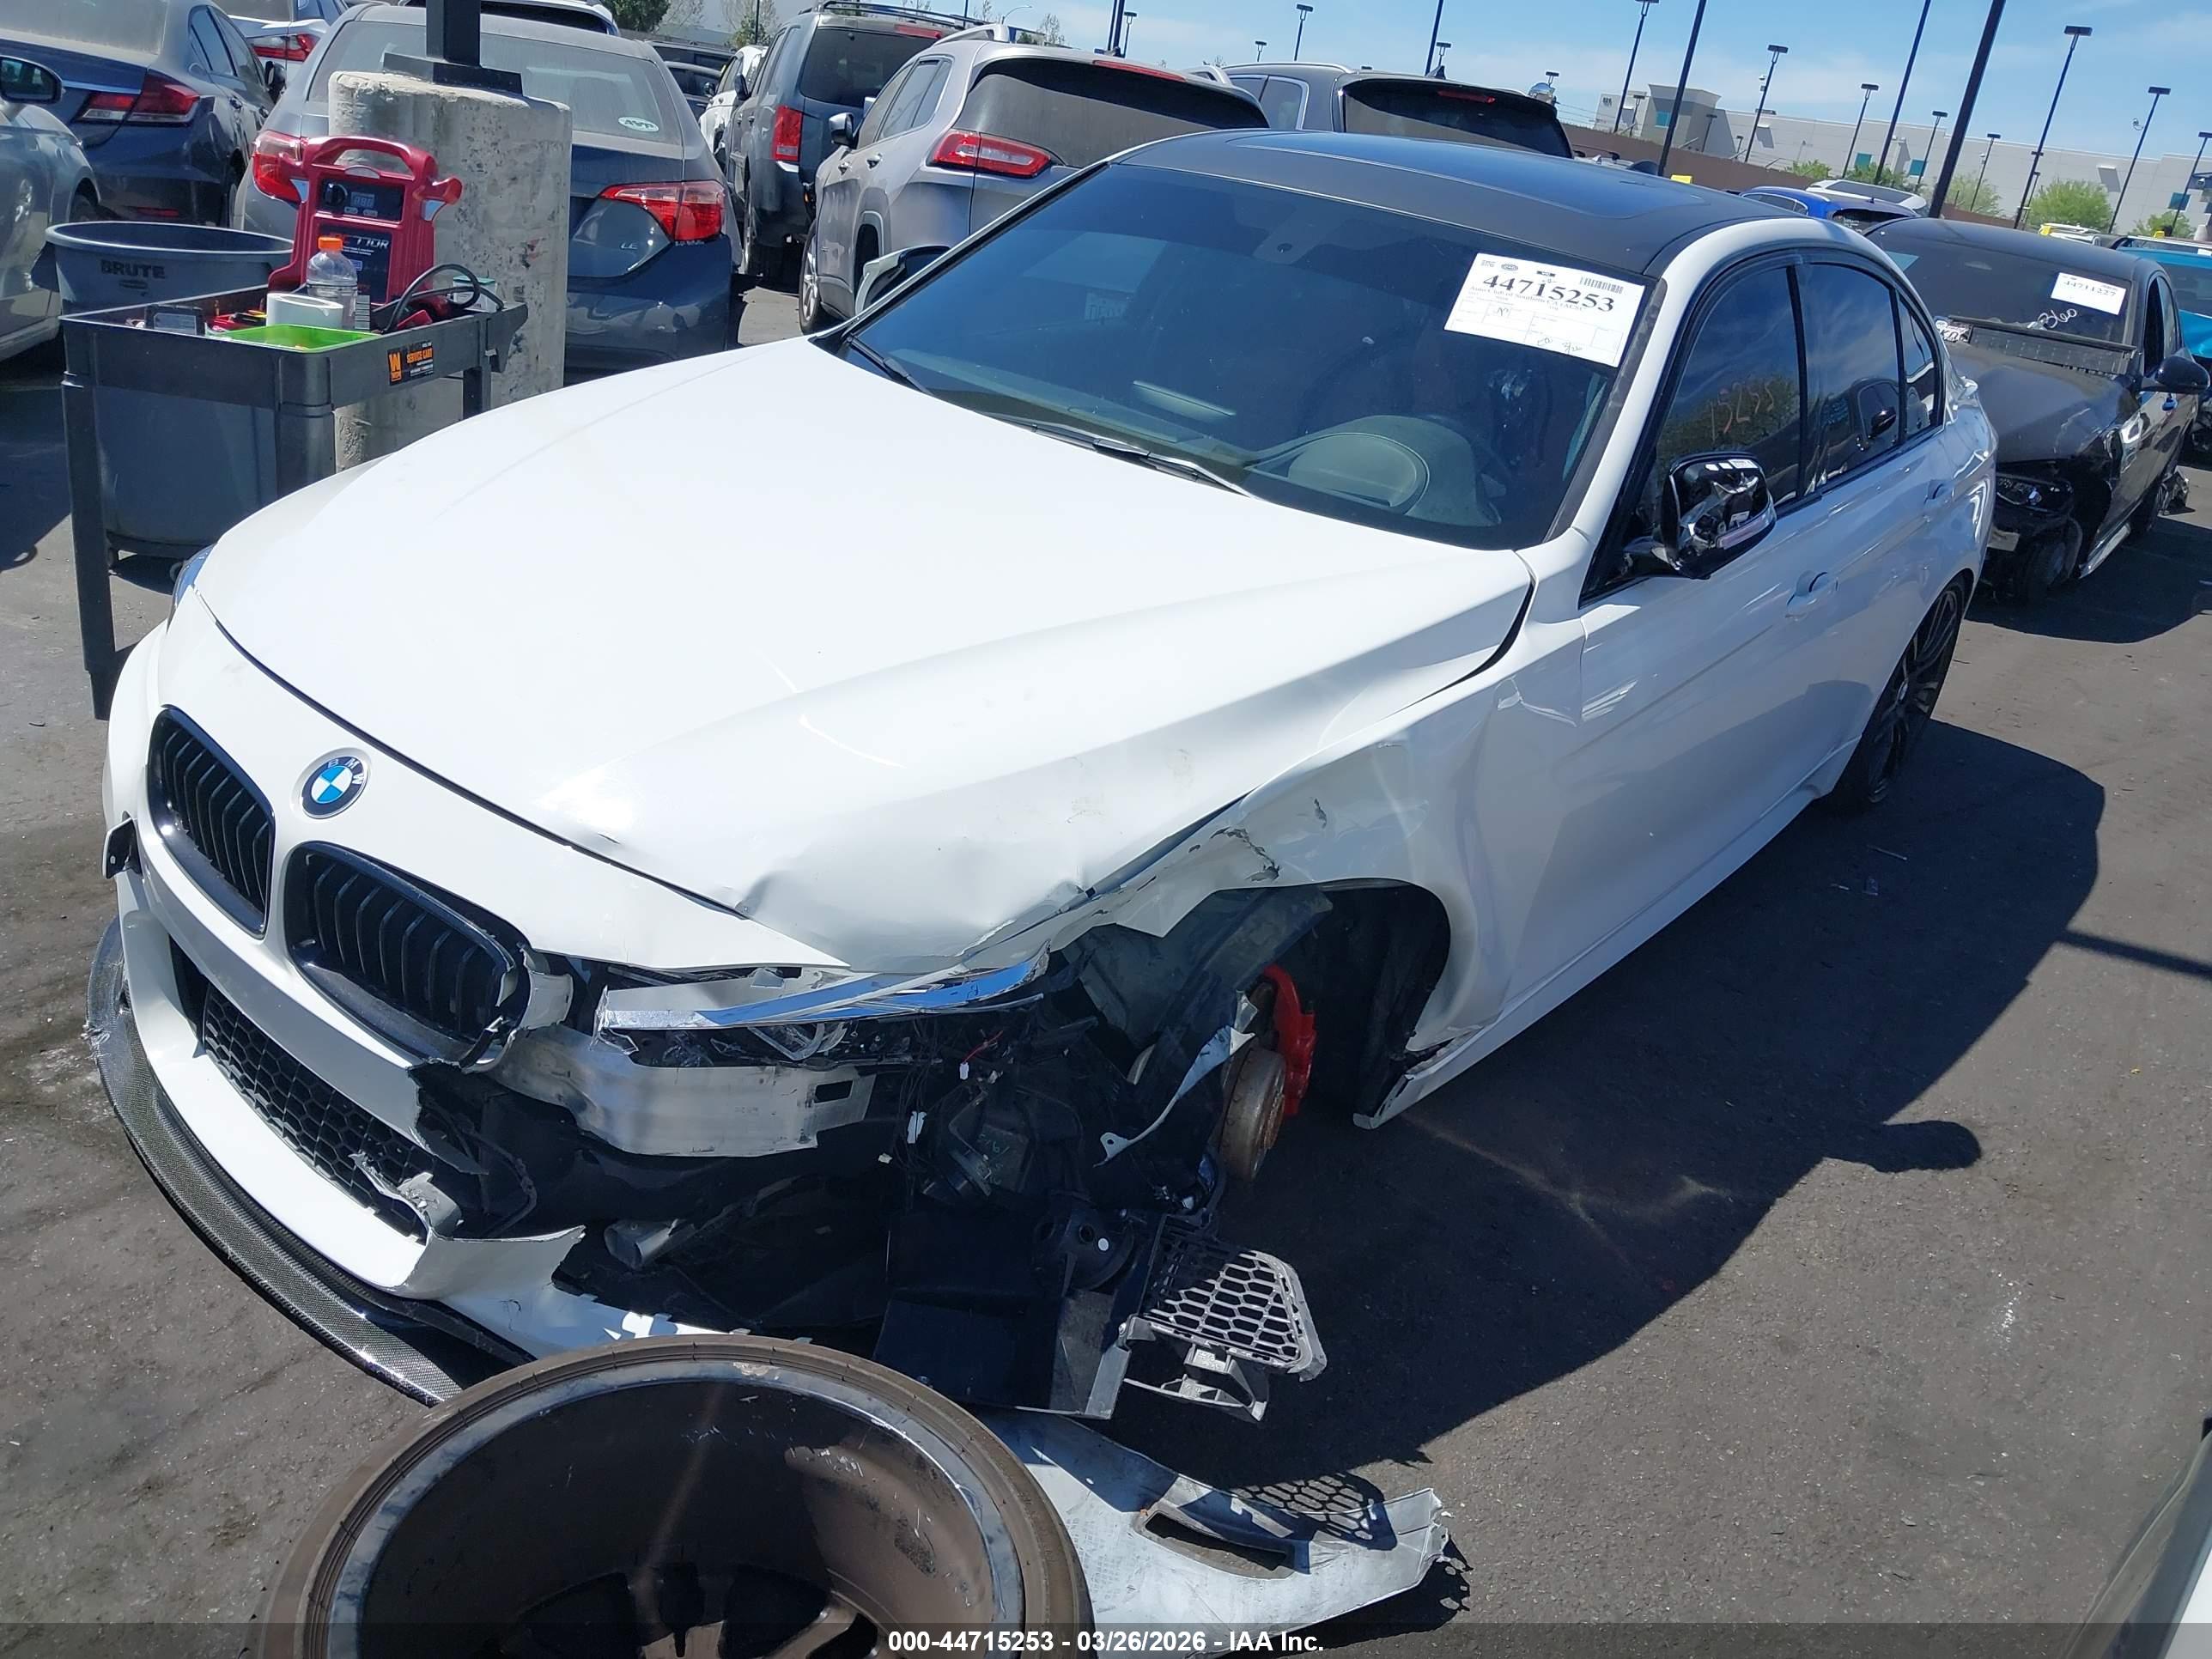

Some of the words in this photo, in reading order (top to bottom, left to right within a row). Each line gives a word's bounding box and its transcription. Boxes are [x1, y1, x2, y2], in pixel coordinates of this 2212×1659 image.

[101, 259, 165, 279] BRUTE
[1483, 275, 1614, 312] 44715253
[327, 757, 364, 785] BMW
